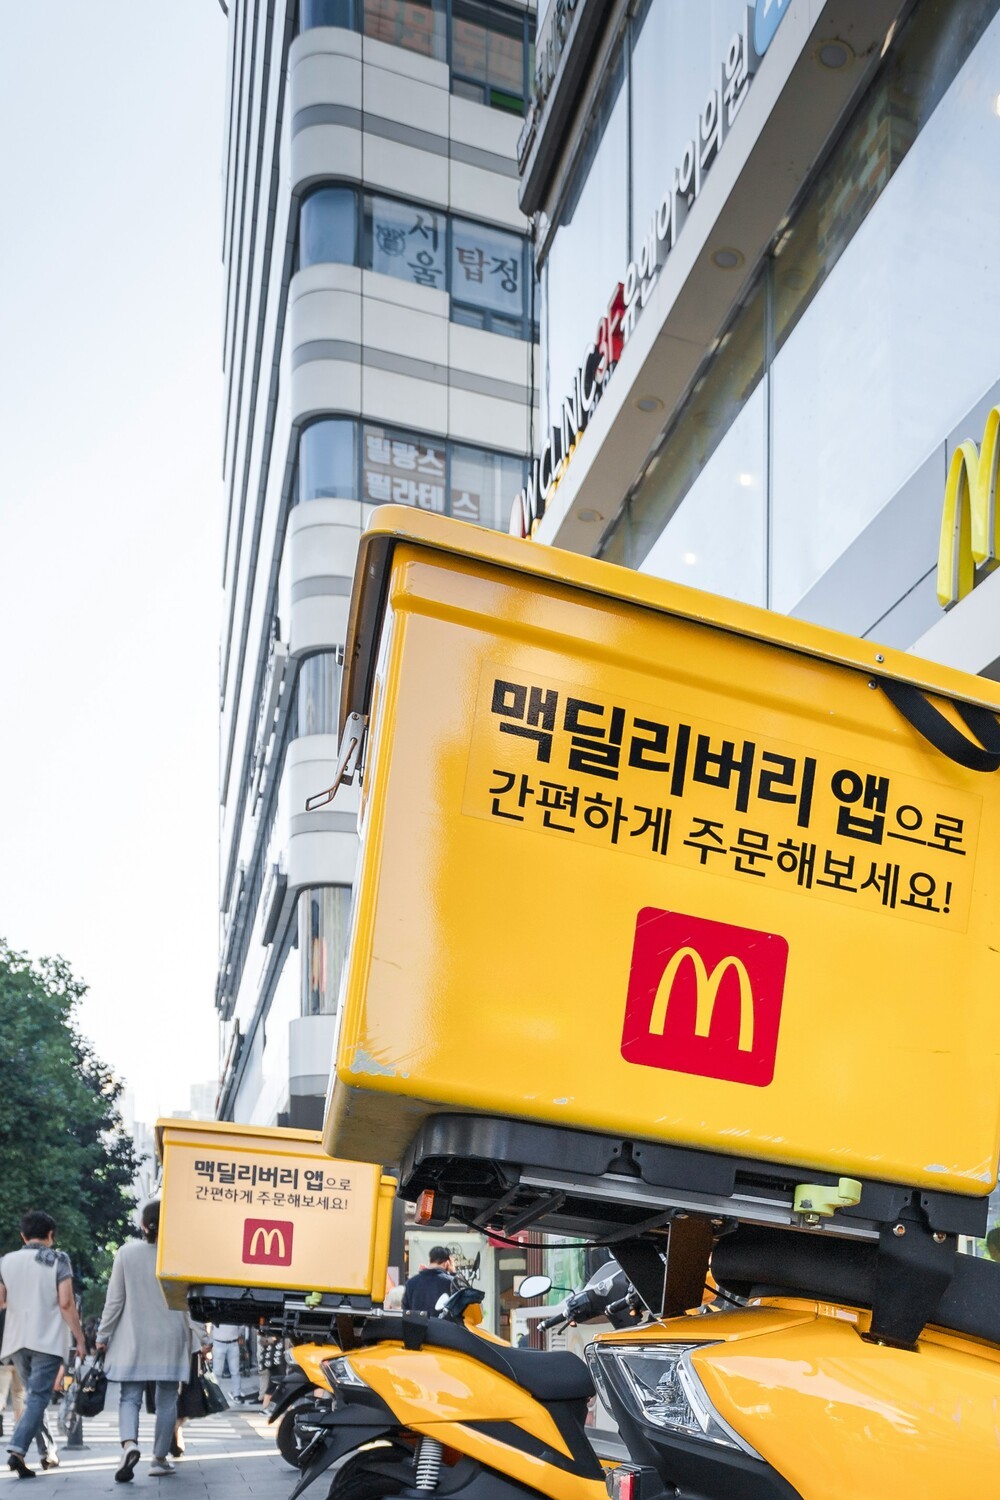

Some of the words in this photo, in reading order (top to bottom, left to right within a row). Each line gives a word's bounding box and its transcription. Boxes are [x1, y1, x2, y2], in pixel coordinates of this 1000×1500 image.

[491, 678, 817, 828] 맥딜리버리
[830, 768, 967, 856] 앱으로
[488, 769, 673, 856] 간편하게
[683, 816, 953, 914] 주문해보세요!
[194, 1160, 299, 1190] 맥딜리버리
[304, 1170, 352, 1192] 앱으로
[195, 1185, 253, 1204] 간편하게
[257, 1191, 348, 1210] 주문해보세요!
